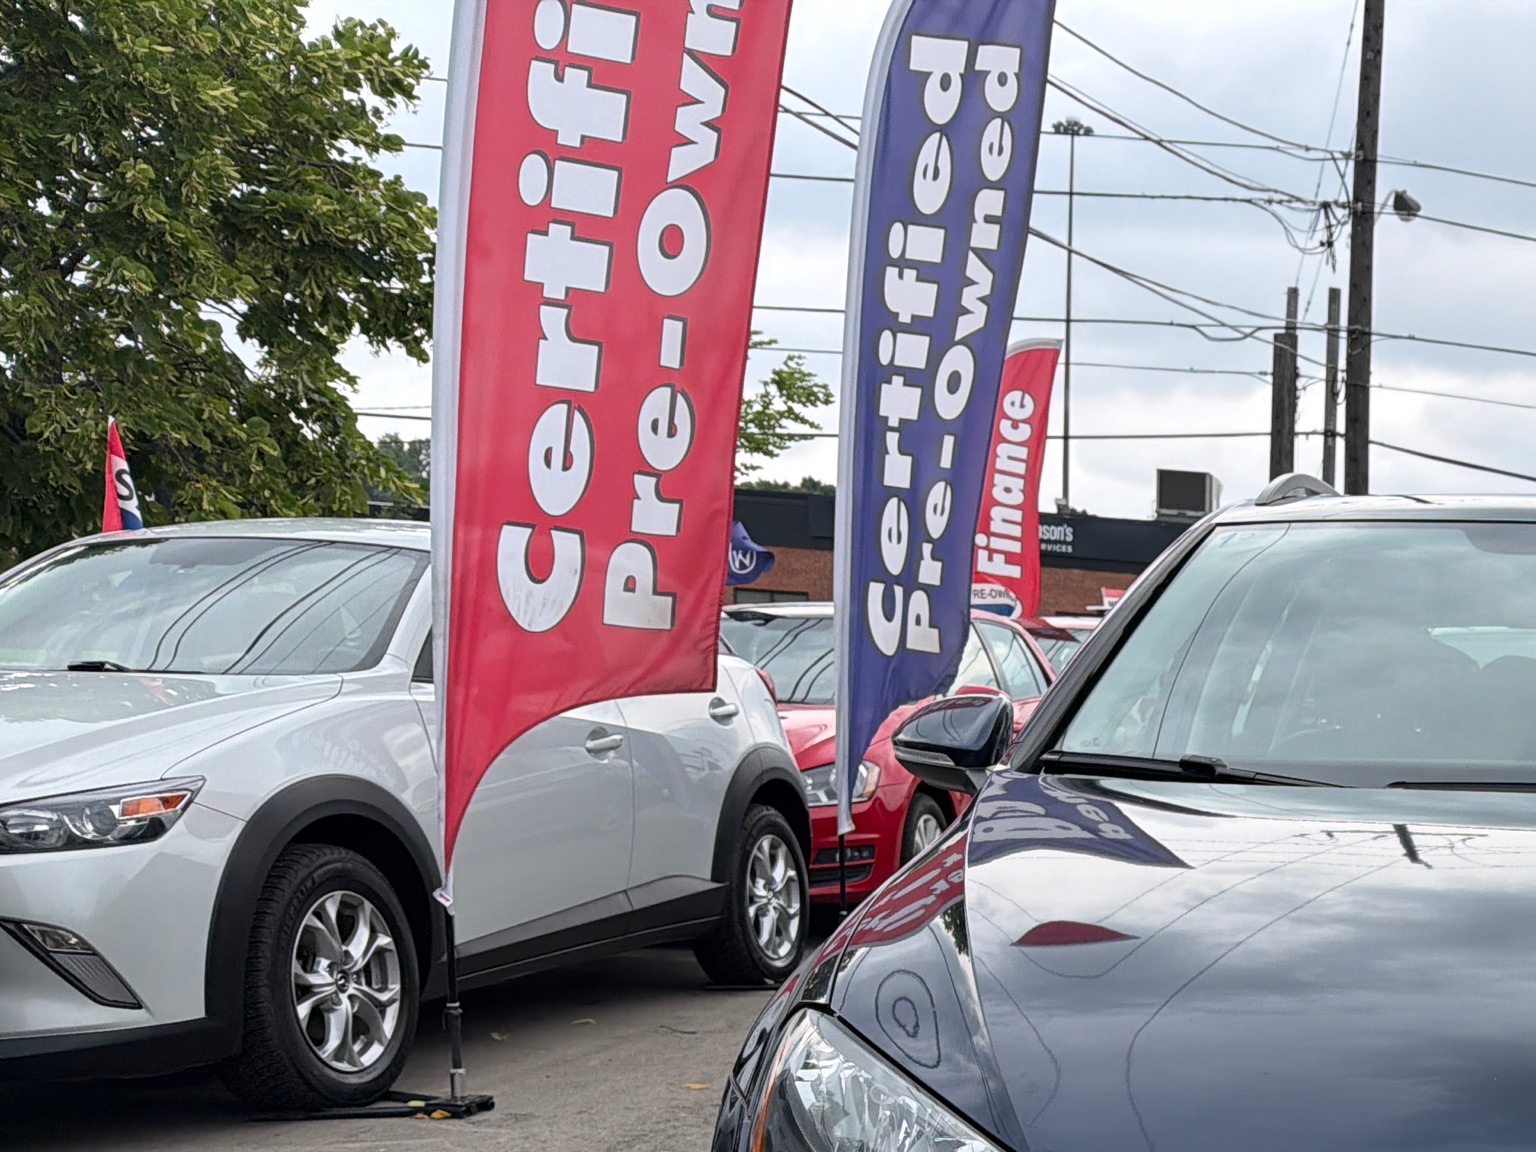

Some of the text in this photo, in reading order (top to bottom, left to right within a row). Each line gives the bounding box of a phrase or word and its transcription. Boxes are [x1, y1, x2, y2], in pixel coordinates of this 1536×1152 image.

[867, 34, 969, 656] Certified
[905, 43, 1022, 655] Pre-Owned
[975, 389, 1036, 579] Finance
